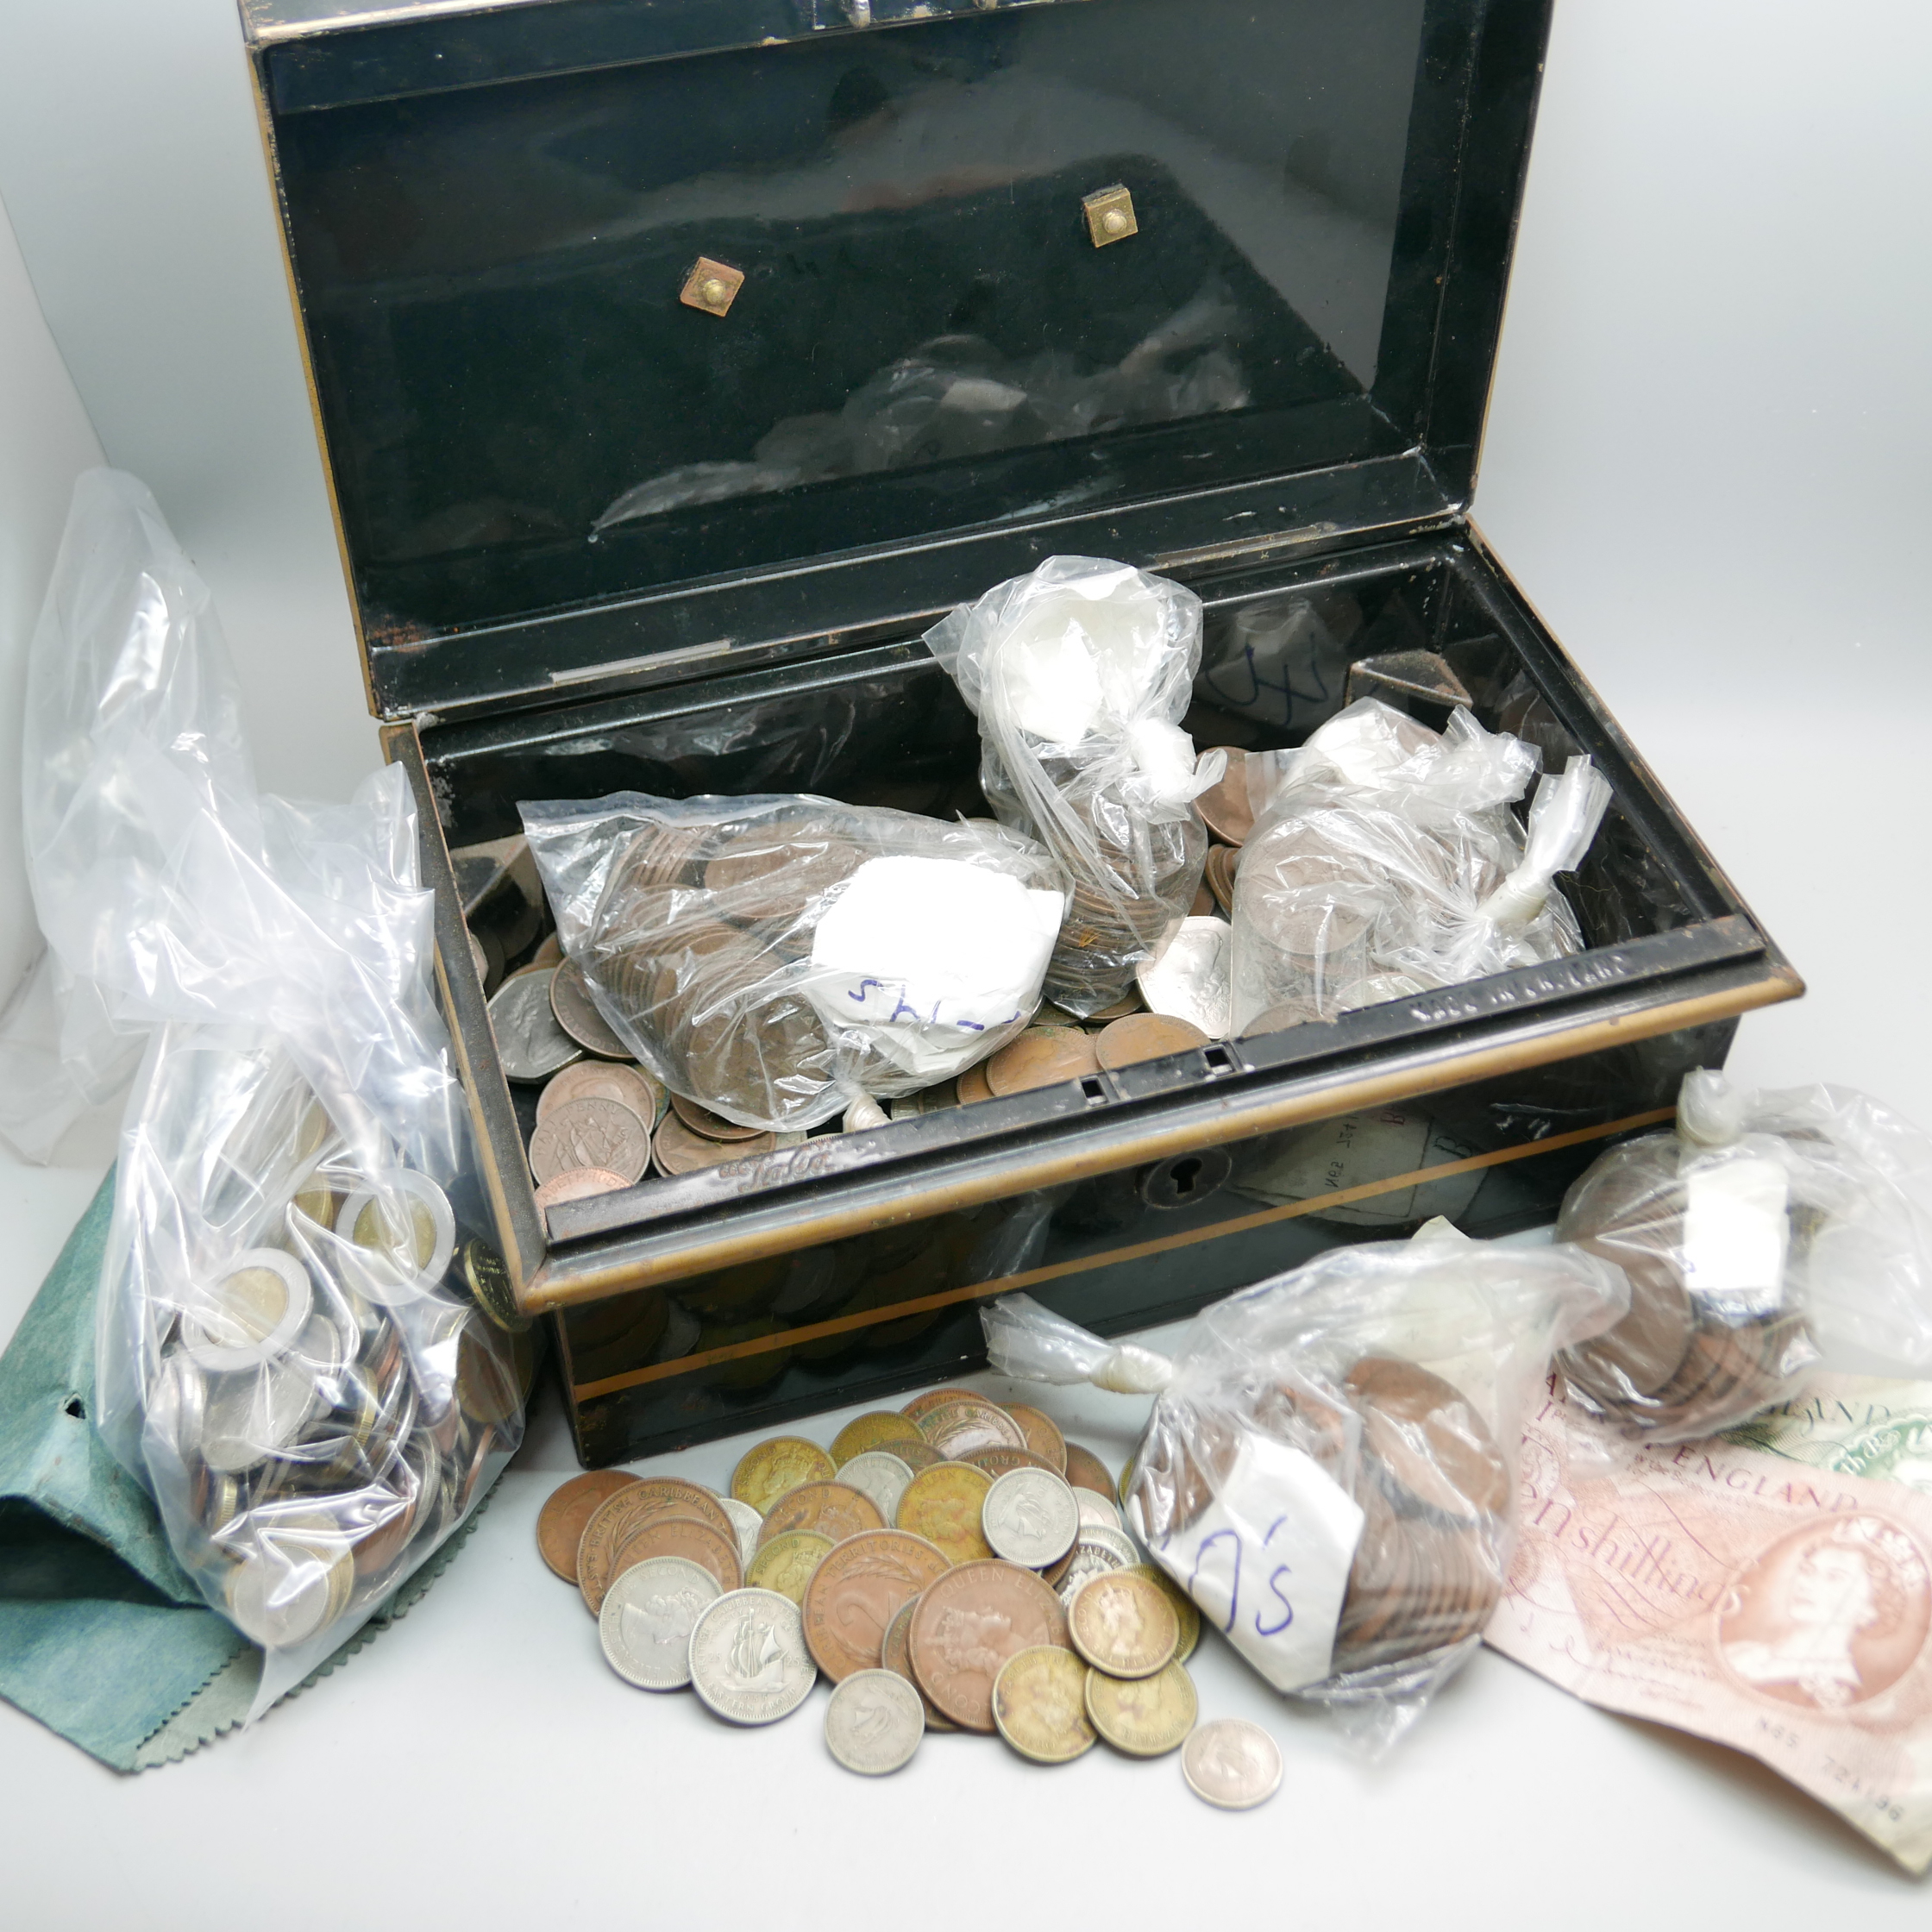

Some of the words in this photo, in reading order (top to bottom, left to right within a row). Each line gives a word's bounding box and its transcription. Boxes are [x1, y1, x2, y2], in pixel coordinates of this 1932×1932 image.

[1672, 1446, 1859, 1514] ENGLAND
[637, 1485, 720, 1521] CARIBBEAN
[755, 1538, 800, 1575] SECOND
[825, 1540, 924, 1578] TERRITORIES
[639, 1565, 700, 1585] SECOND
[940, 1567, 1005, 1602] QUEEN
[697, 1627, 712, 1675] BRITISH
[711, 1596, 774, 1622] CARIBBEAN
[707, 1652, 723, 1663] 25
[786, 1655, 801, 1667] 25
[706, 1682, 755, 1712] EASTERN
[761, 1687, 797, 1712] GROUP
